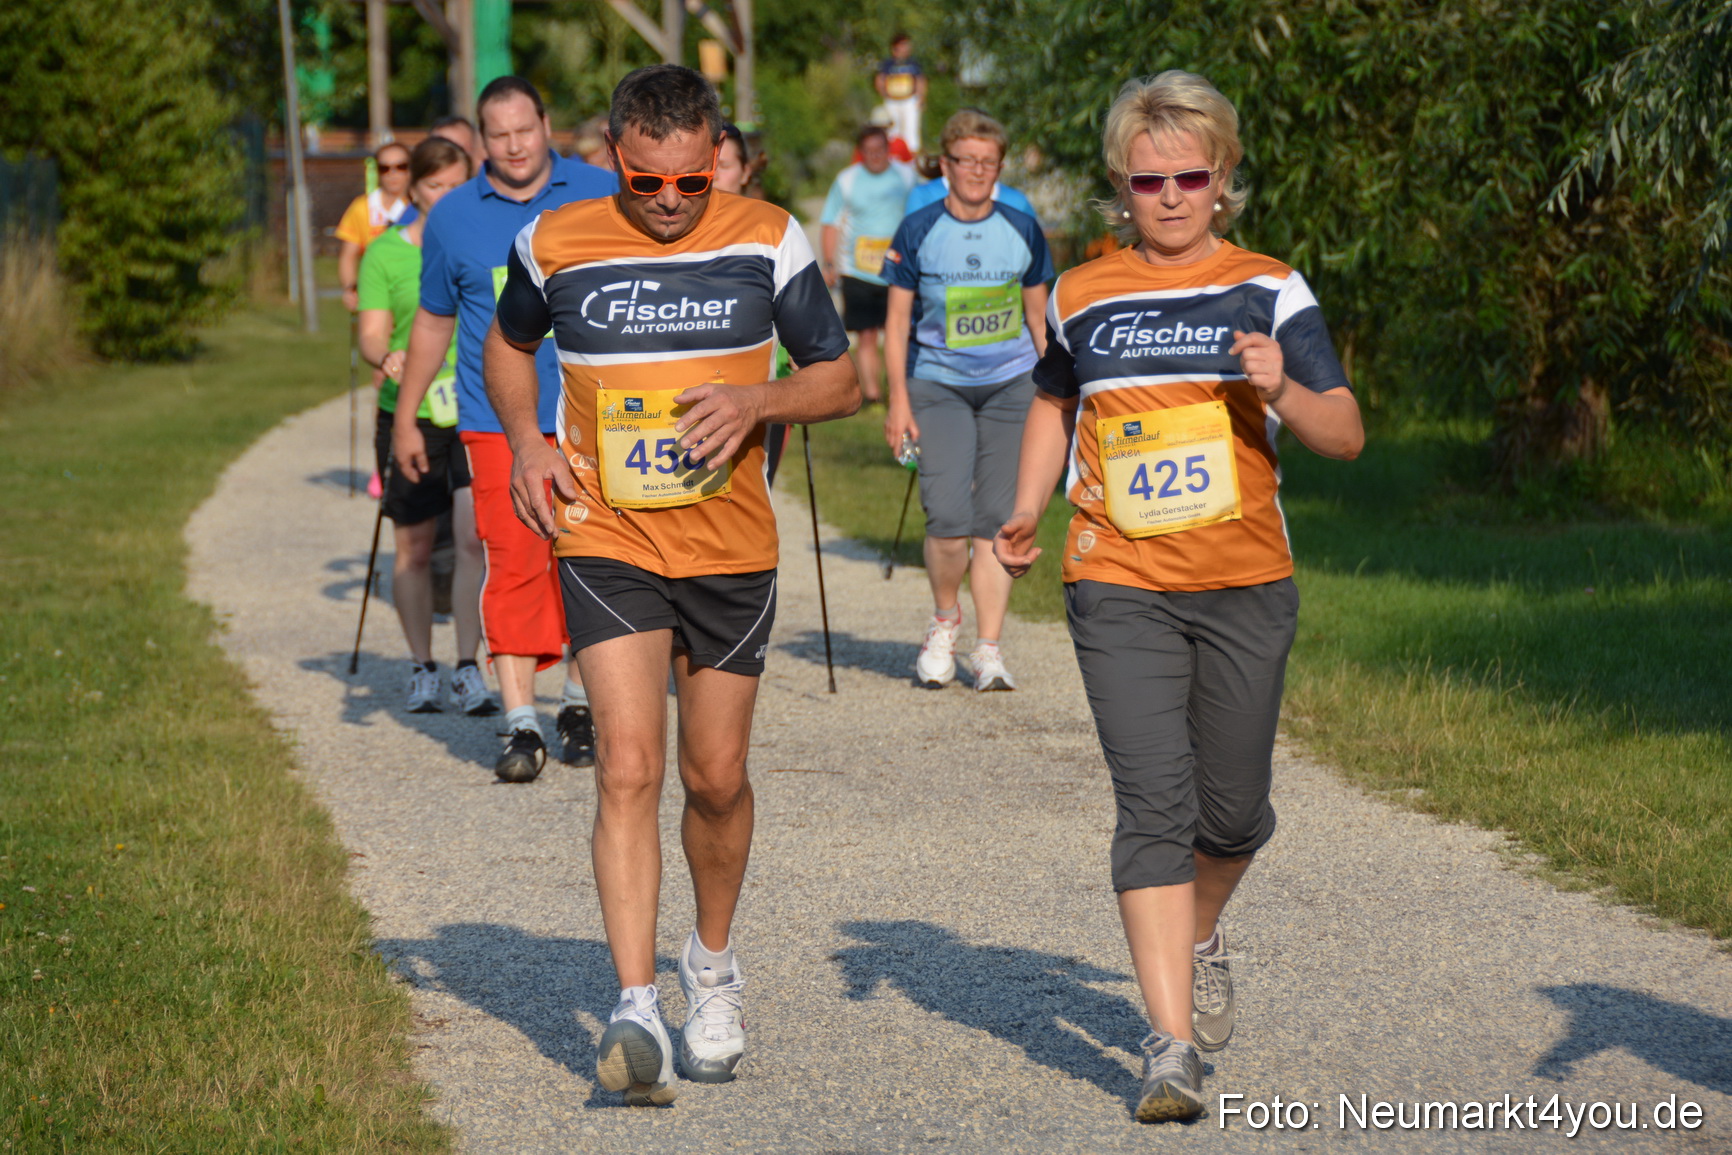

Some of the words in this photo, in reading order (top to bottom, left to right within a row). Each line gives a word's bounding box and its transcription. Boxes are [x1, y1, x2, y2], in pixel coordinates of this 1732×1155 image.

[607, 296, 738, 322] Fischer
[620, 318, 731, 334] AUTOMOBILE
[956, 309, 1013, 336] 6087
[1110, 321, 1228, 348] Fischer
[1120, 344, 1219, 359] AUTOMOBILE
[615, 410, 662, 420] firmenlauf
[604, 422, 640, 433] walken
[1116, 430, 1160, 445] firmenlauf
[1106, 447, 1141, 461] walken
[1128, 454, 1210, 501] 425
[642, 484, 659, 492] Max
[660, 480, 695, 490] Schmidt
[1139, 509, 1161, 520] Lydia
[1161, 502, 1207, 515] Gerstacker
